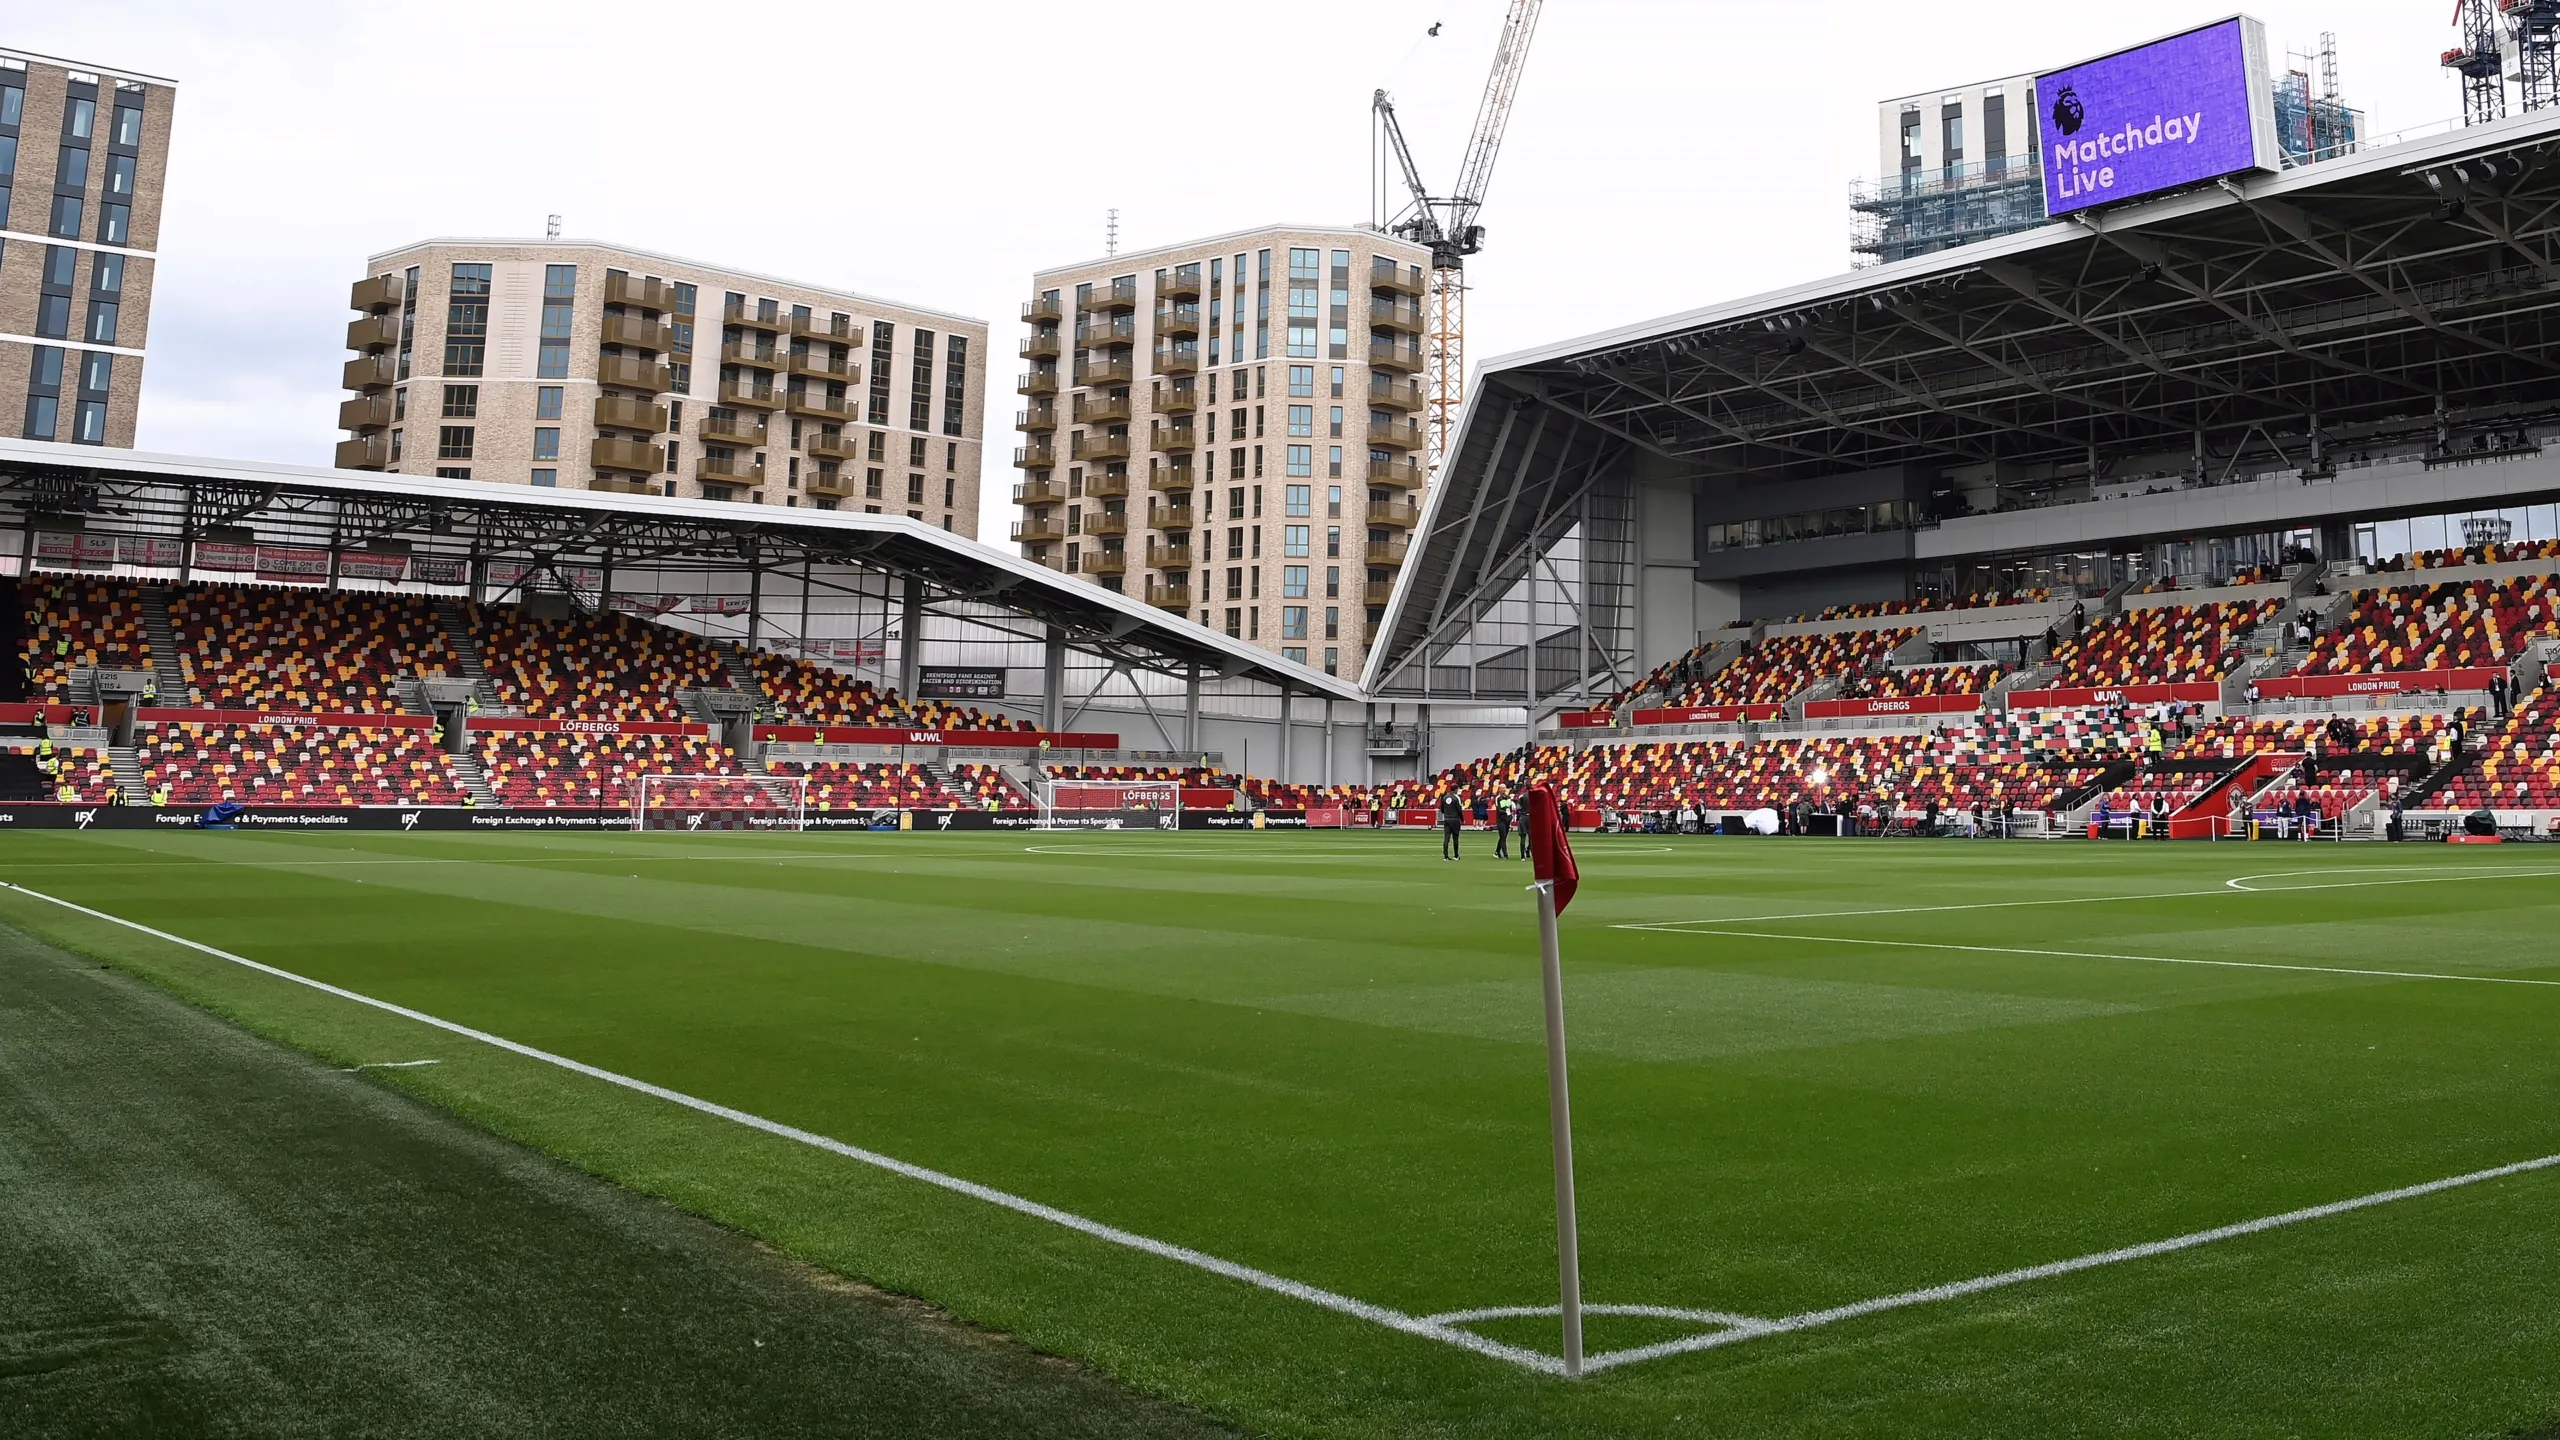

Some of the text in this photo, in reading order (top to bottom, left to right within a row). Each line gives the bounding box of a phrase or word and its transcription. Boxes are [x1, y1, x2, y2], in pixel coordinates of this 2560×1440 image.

[2055, 112, 2200, 169] Matchday
[2058, 167, 2114, 198] Live
[273, 559, 297, 567] COME
[354, 564, 392, 572] BRENTFORD
[2348, 681, 2400, 691] LONDON PRIDE
[1868, 701, 1910, 711] LÖFBERGS
[258, 715, 318, 725] LONDON PRIDE
[1689, 712, 1707, 720] LONDON
[560, 720, 620, 732] LÖFBERGS
[1122, 790, 1171, 800] LÖFBERGS
[74, 808, 97, 829] IFX
[156, 814, 192, 825] Foreign
[242, 815, 250, 823] &
[251, 815, 298, 825] Payments
[299, 815, 348, 826] Specialists
[401, 810, 421, 830] IFX
[472, 816, 504, 826] Foreign
[505, 816, 546, 826] Exchange
[547, 816, 554, 824] &
[555, 816, 596, 826] Payments
[686, 812, 704, 831] IFX
[749, 817, 777, 826] Foreign
[822, 817, 858, 826] Payments
[938, 813, 953, 830] IFX
[992, 817, 1018, 826] Foreign
[1208, 817, 1230, 825] Foreign
[1265, 818, 1293, 826] Payments
